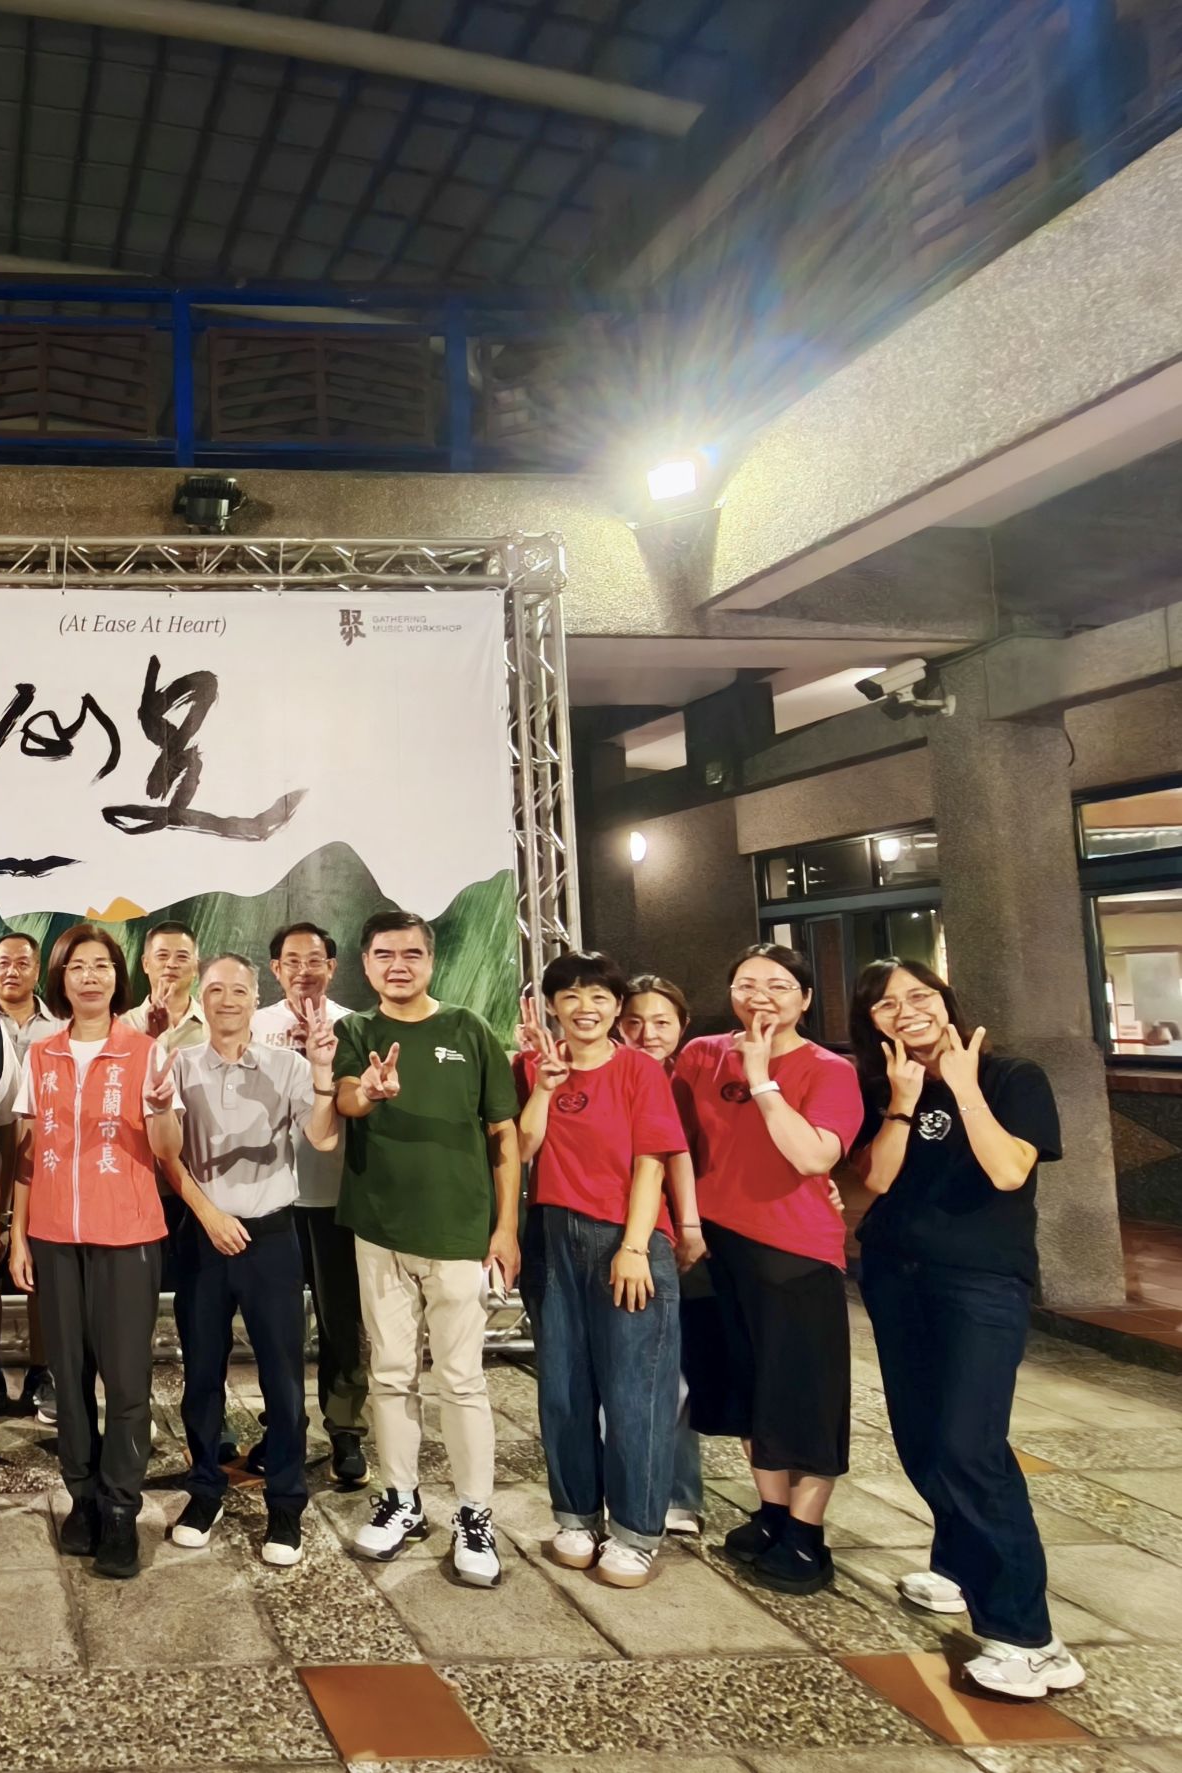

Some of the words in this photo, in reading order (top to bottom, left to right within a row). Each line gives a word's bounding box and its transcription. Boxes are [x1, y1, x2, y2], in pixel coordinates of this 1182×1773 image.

[59, 613, 88, 636] (At
[92, 614, 137, 633] Ease
[141, 615, 163, 633] At
[167, 615, 227, 638] Heart)
[371, 615, 427, 624] GATHERING
[371, 625, 404, 633] MUSIC
[406, 624, 463, 633] WORKSHOP
[96, 1063, 126, 1174] 宜蘭市長
